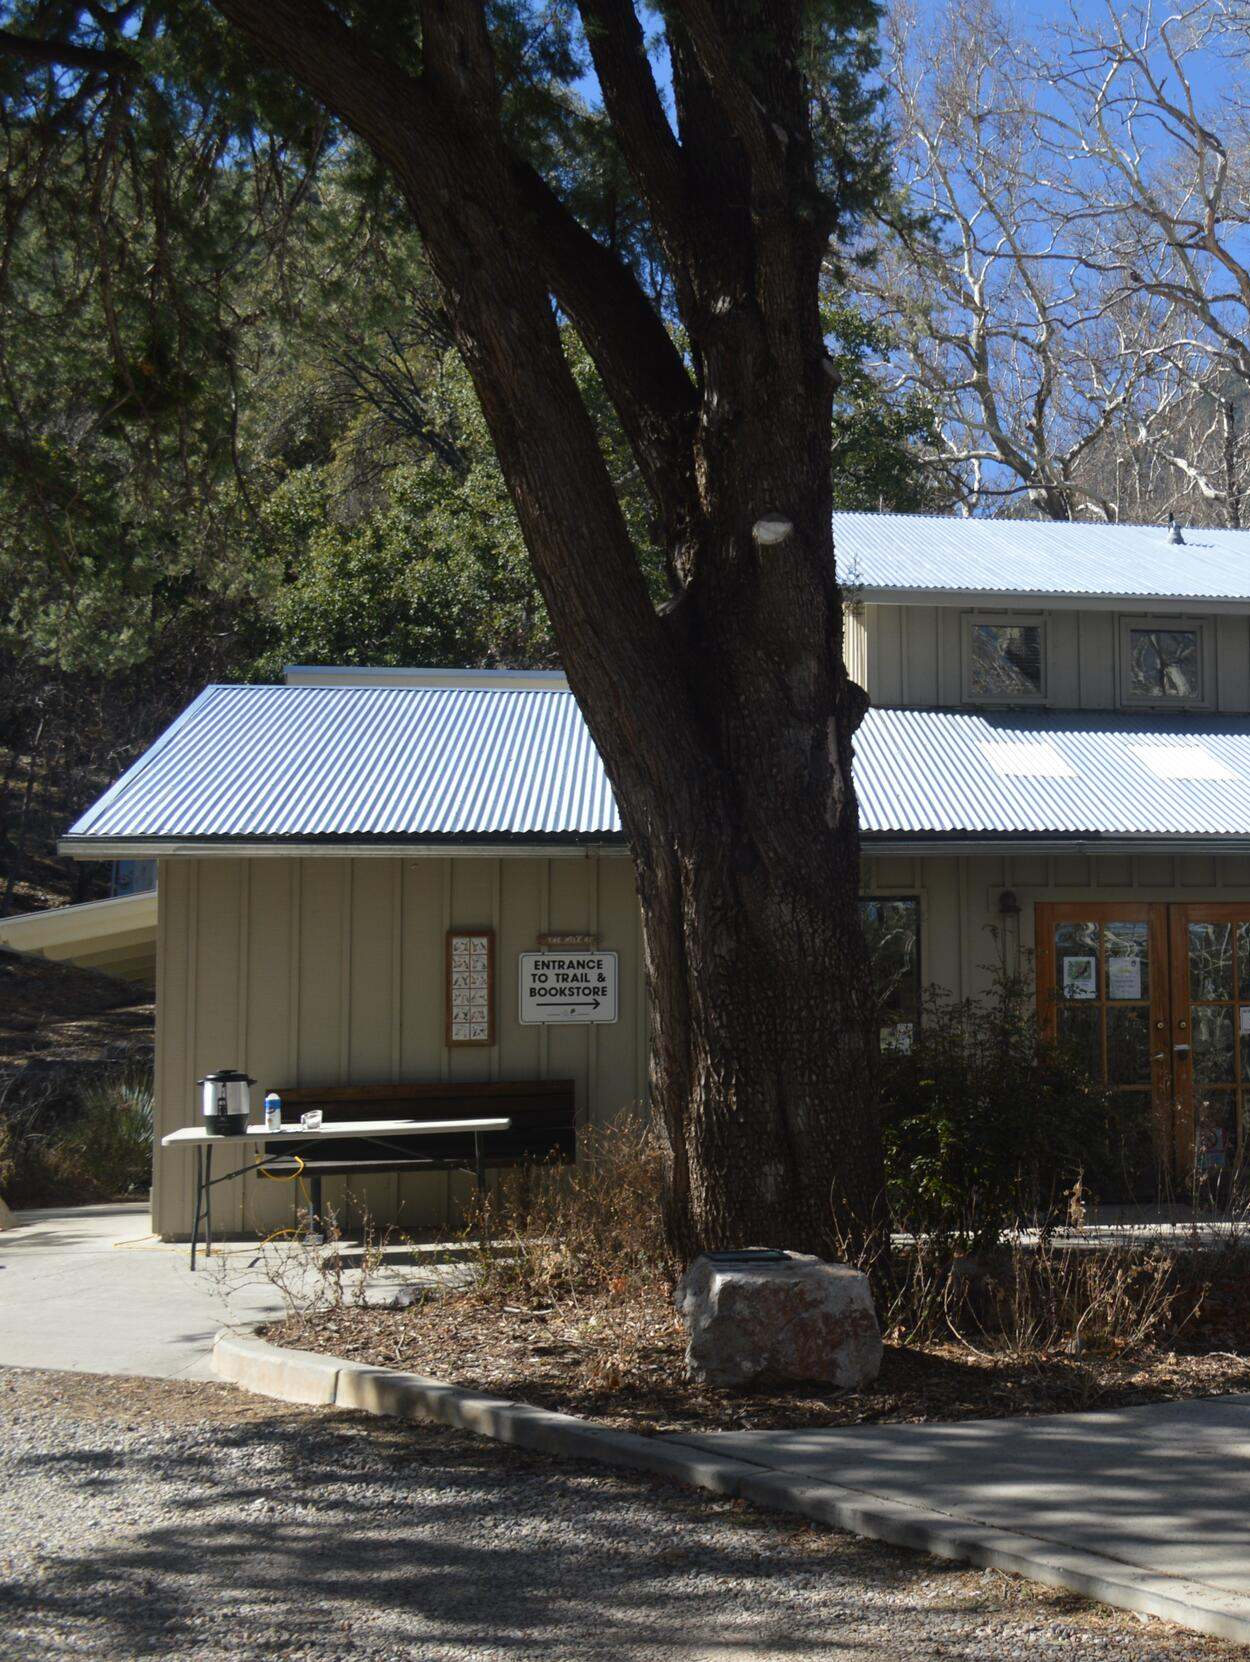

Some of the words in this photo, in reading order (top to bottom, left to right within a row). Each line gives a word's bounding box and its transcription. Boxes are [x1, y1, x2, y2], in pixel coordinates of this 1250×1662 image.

[534, 960, 603, 971] ENTRANCE
[531, 973, 548, 984] TO
[555, 972, 591, 983] TRAIL
[597, 972, 606, 983] &
[529, 986, 608, 997] BOOKSTORE
